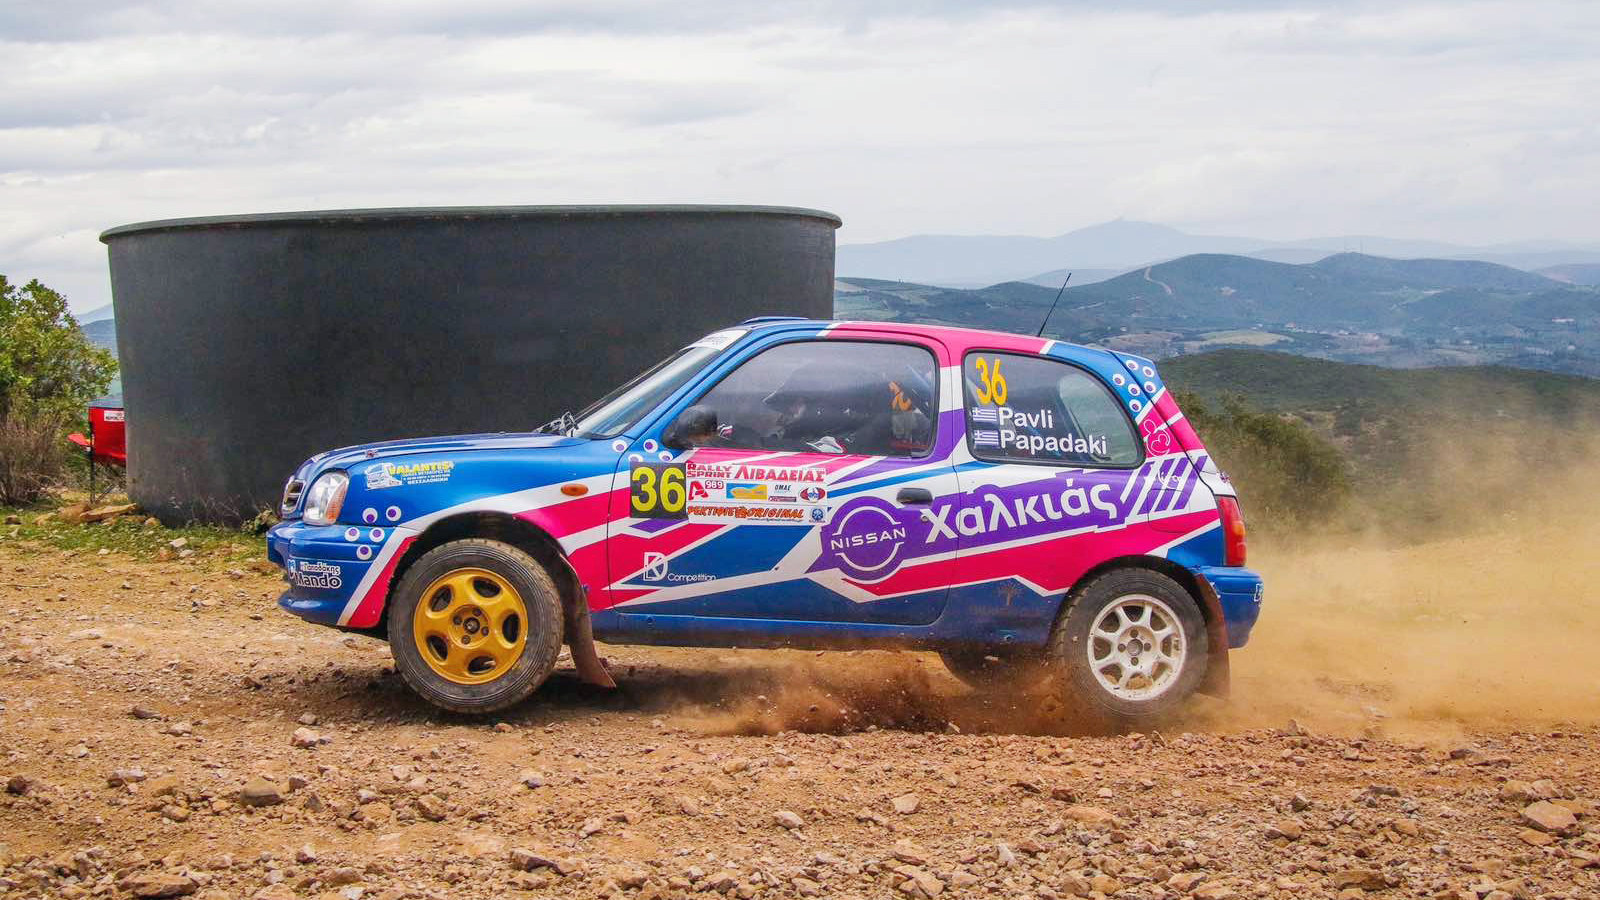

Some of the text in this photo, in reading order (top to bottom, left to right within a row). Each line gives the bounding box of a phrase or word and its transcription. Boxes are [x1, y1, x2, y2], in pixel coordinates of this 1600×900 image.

[975, 356, 1008, 406] 36
[999, 407, 1053, 429] Pavli
[1000, 429, 1107, 455] Papadaki
[686, 463, 733, 472] RALLY
[686, 470, 732, 479] SPRINT
[734, 465, 827, 482] ΛΙΒΑΔΕΙΑΣ
[631, 466, 686, 513] 36
[831, 527, 906, 551] NISSAN
[295, 572, 342, 589] Mando
